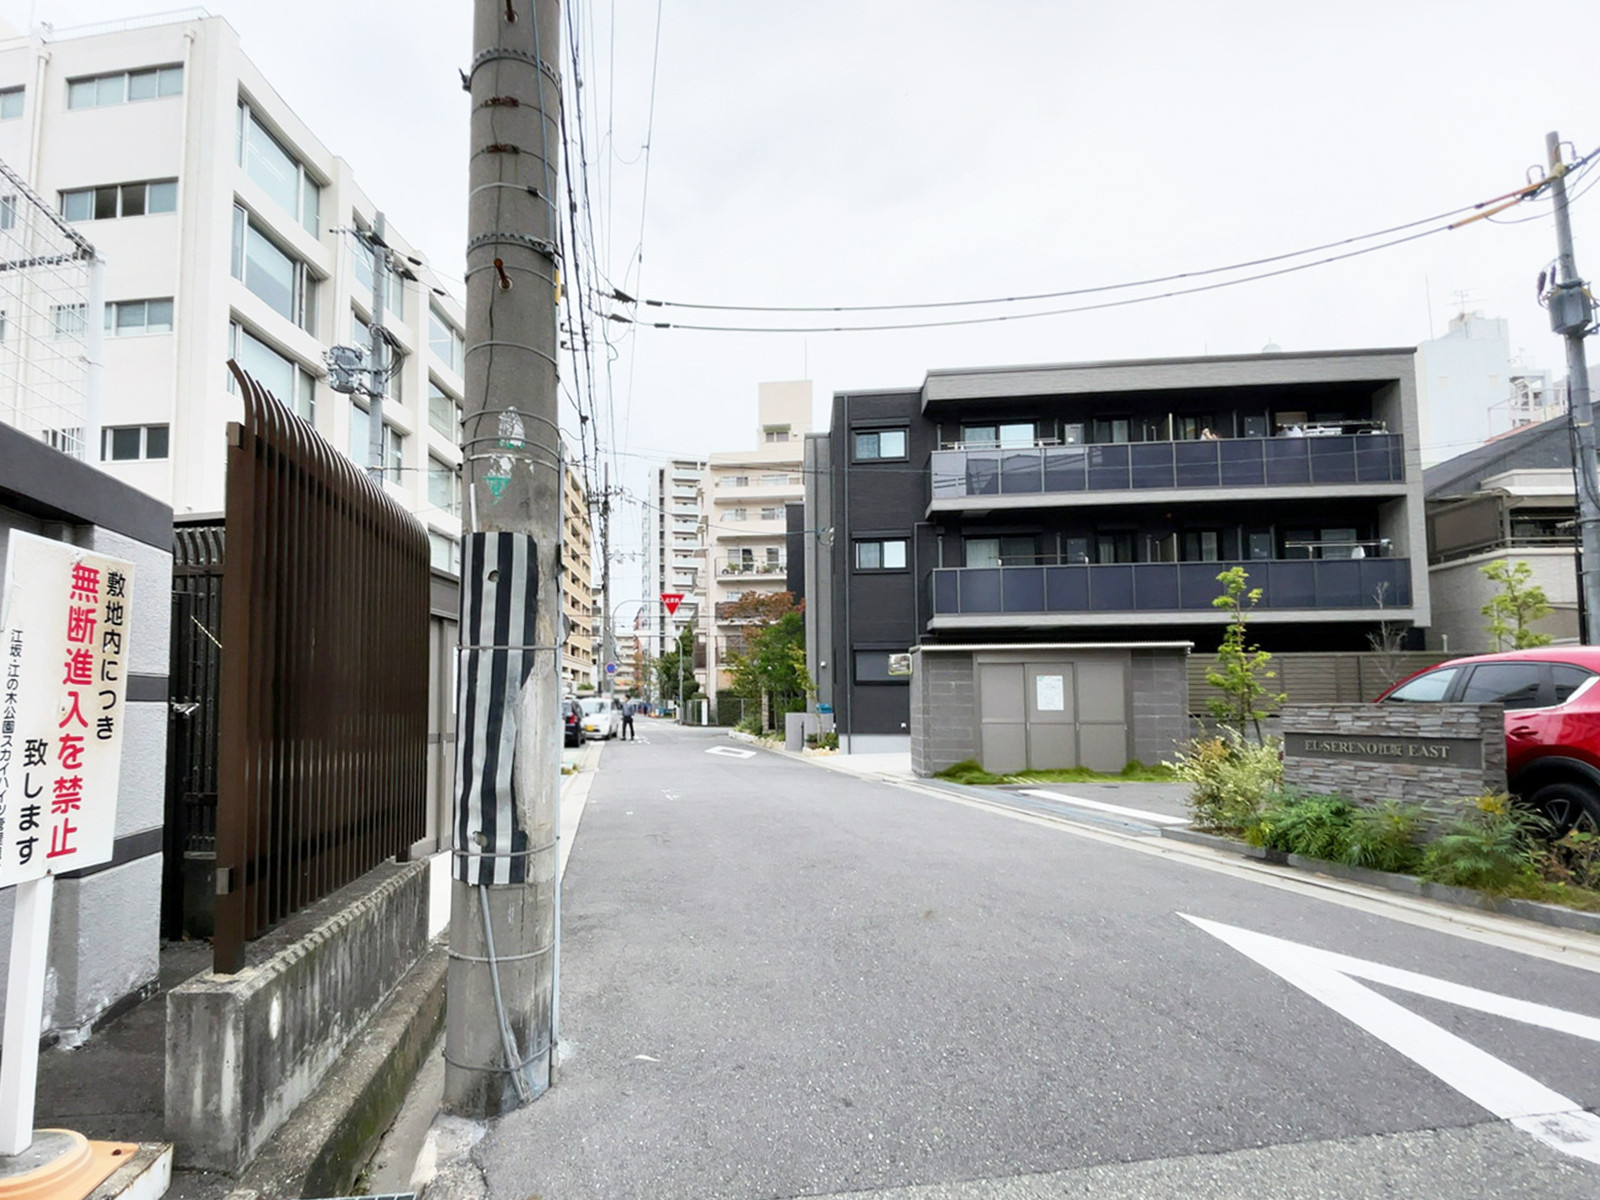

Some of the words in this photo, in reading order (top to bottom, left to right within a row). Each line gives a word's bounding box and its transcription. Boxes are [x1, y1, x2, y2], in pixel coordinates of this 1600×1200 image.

[46, 562, 100, 859] 無断進入を禁止
[96, 570, 127, 740] 敷地内につき
[16, 738, 49, 866] 致します
[1408, 744, 1451, 759] EAST
